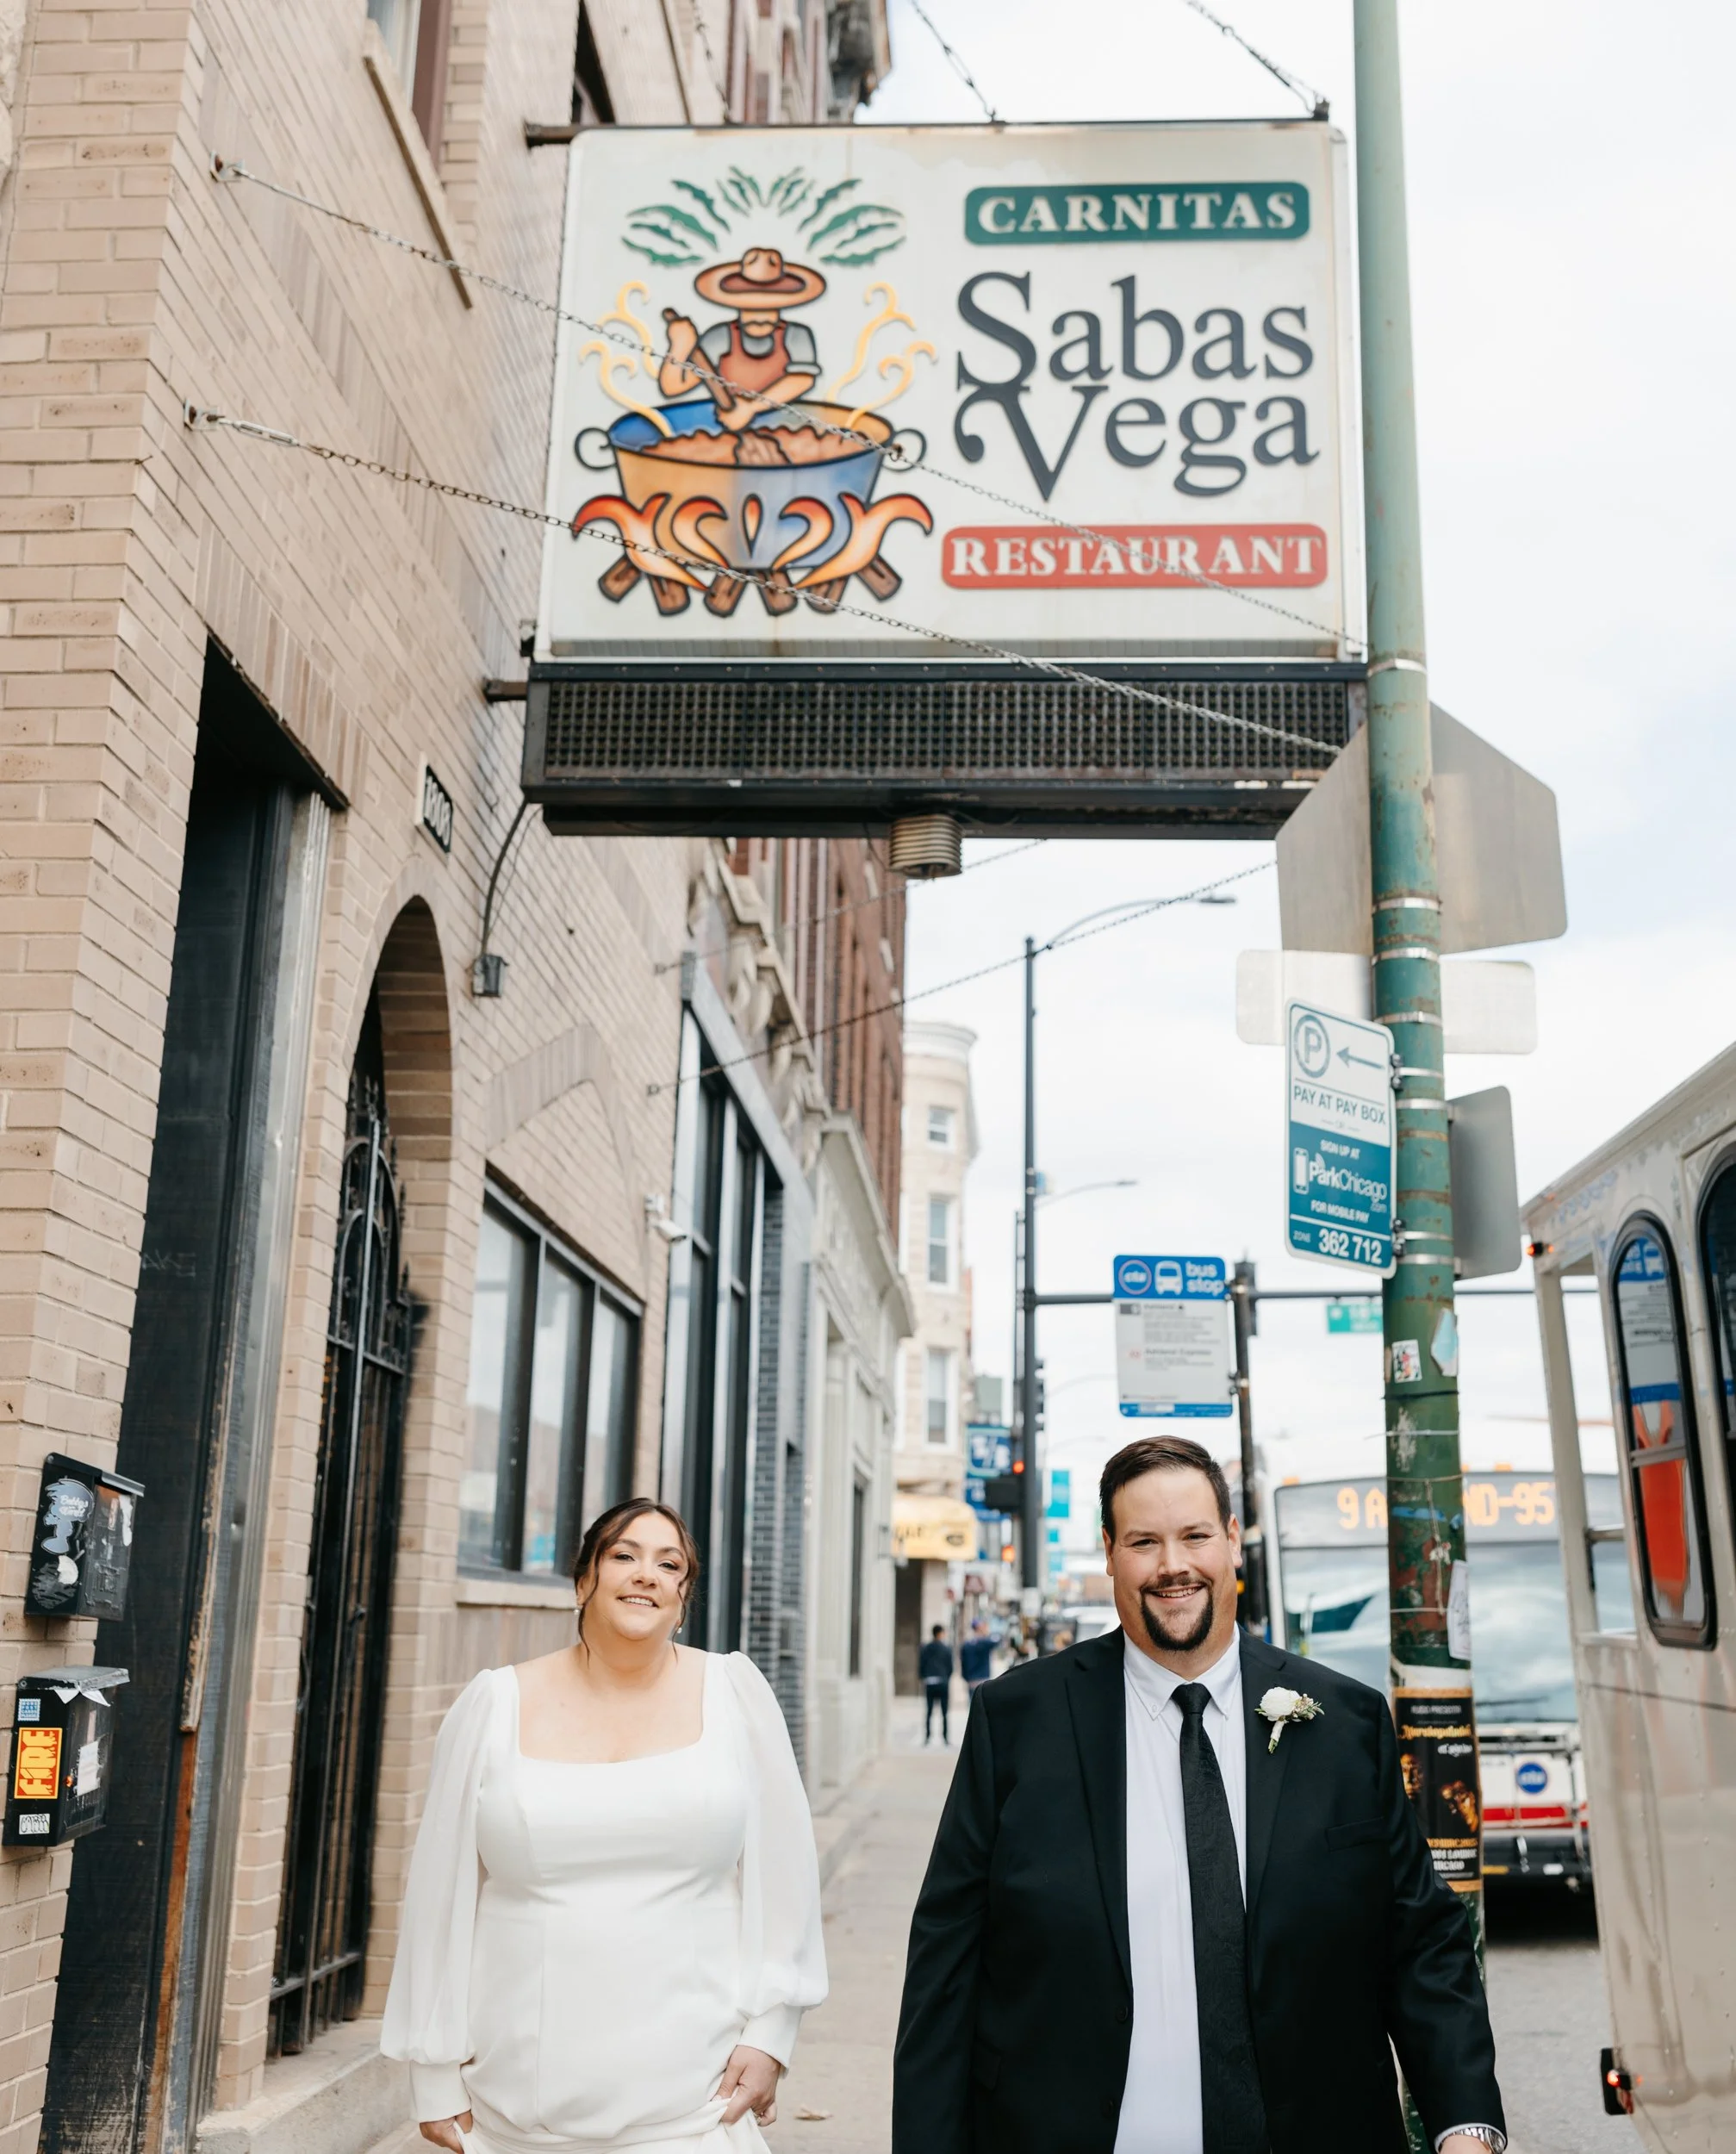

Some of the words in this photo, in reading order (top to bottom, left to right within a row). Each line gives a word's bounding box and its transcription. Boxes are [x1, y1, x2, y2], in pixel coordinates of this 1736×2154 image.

[978, 191, 1297, 233] CARNITAS
[956, 271, 1314, 391] Sabas
[954, 383, 1321, 502] Vega
[949, 536, 1322, 577] RESTAURANT
[1293, 1085, 1316, 1105] PAY
[1318, 1093, 1332, 1111] AT
[1336, 1097, 1358, 1117] PAY
[1361, 1104, 1386, 1127] BOX
[1309, 1160, 1387, 1204] ParkChicago
[1310, 1198, 1328, 1215] FOR
[1328, 1203, 1355, 1222] MOBILE
[1318, 1228, 1349, 1258] 362
[1352, 1235, 1383, 1265] 712
[1185, 1261, 1217, 1278] bus
[1186, 1278, 1224, 1297] stop
[1336, 1486, 1360, 1529] 9
[19, 1730, 58, 1796] FIRE
